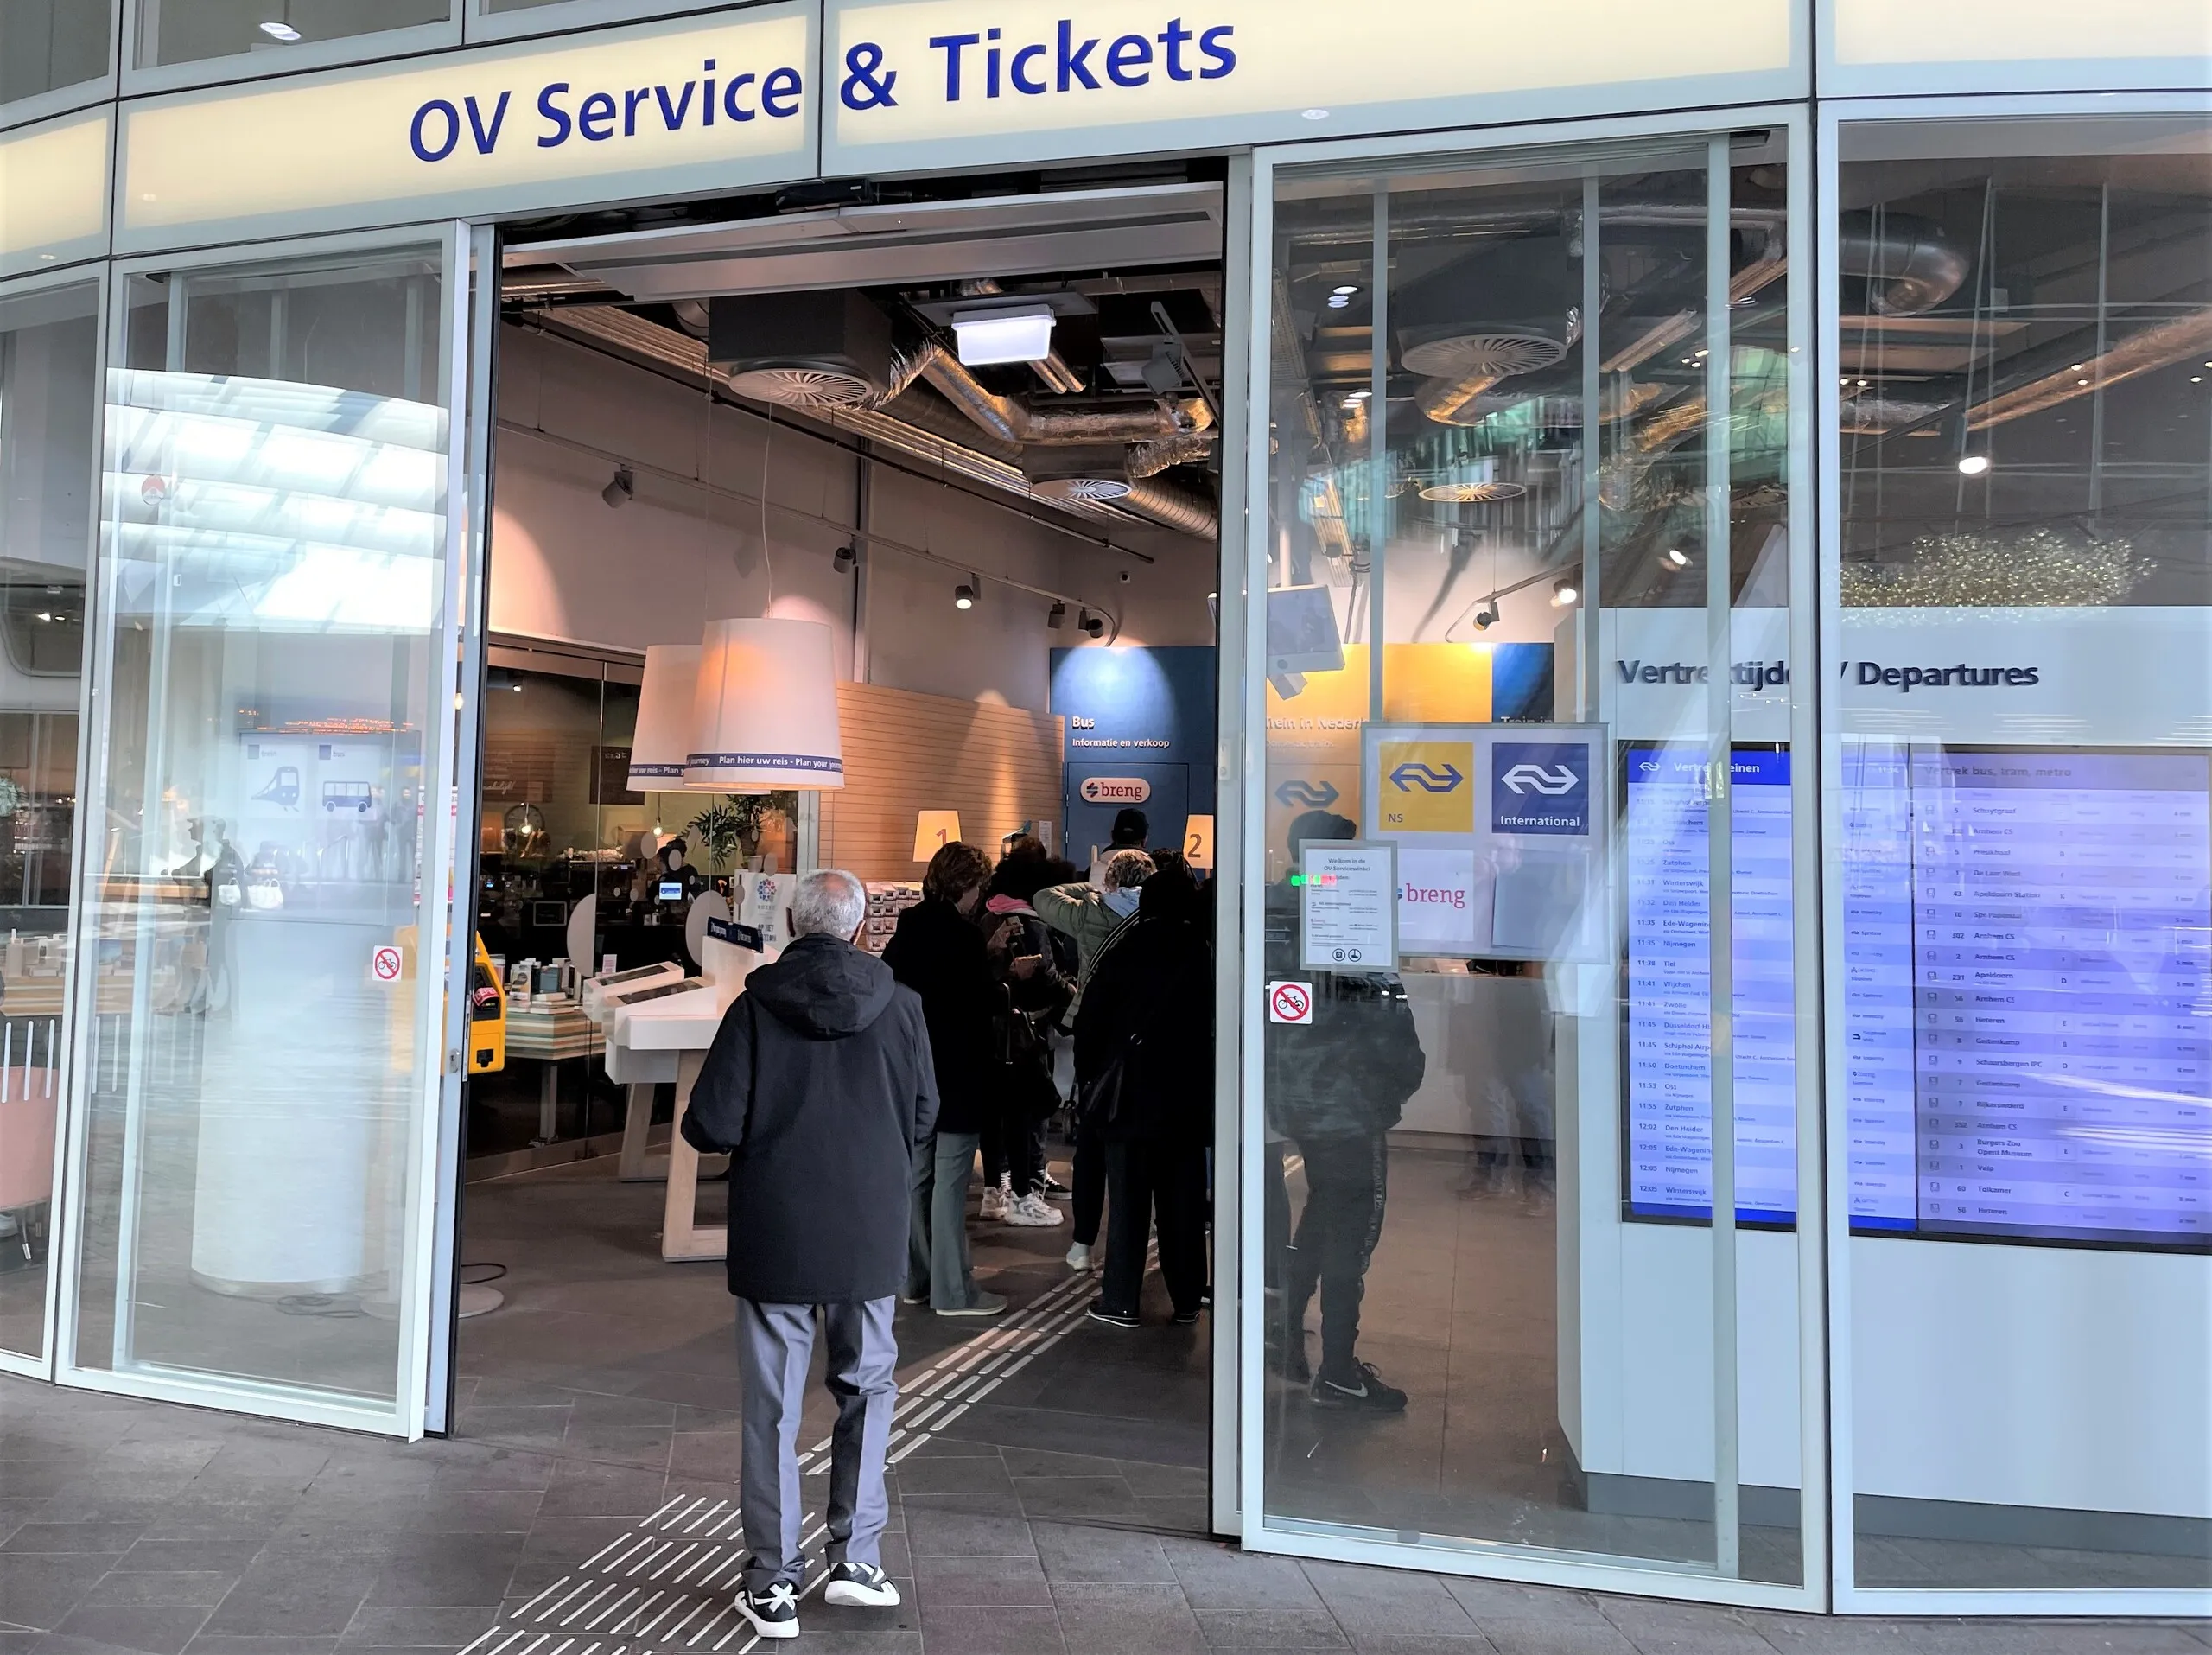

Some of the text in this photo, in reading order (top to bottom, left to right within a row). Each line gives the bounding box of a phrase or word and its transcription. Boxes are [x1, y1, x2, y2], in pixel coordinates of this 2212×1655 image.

[410, 16, 1236, 162] OV Service & Tickets
[1617, 660, 1789, 691] Vertretijd
[1858, 661, 2039, 692] Departures
[1072, 716, 1095, 729] Bus
[1072, 738, 1118, 748] Informatie
[1134, 739, 1170, 749] verkoop
[719, 755, 735, 764] Plan
[737, 755, 753, 765] hier
[772, 757, 788, 766] reis
[796, 758, 811, 767] Plan
[813, 760, 827, 768] your
[1674, 762, 1759, 773] Vertre einen
[1973, 767, 1997, 776] bus,
[2001, 767, 2031, 777] tram,
[1101, 782, 1142, 800] breng
[1388, 813, 1403, 823] NS
[1500, 815, 1580, 827] International
[936, 829, 946, 844] 1
[1188, 834, 1202, 858] 2
[1406, 883, 1465, 908] breng
[1694, 1043, 1711, 1052] Airp
[1665, 1145, 1712, 1154] Ede-Wagenin
[1666, 1187, 1707, 1195] Winterswijk
